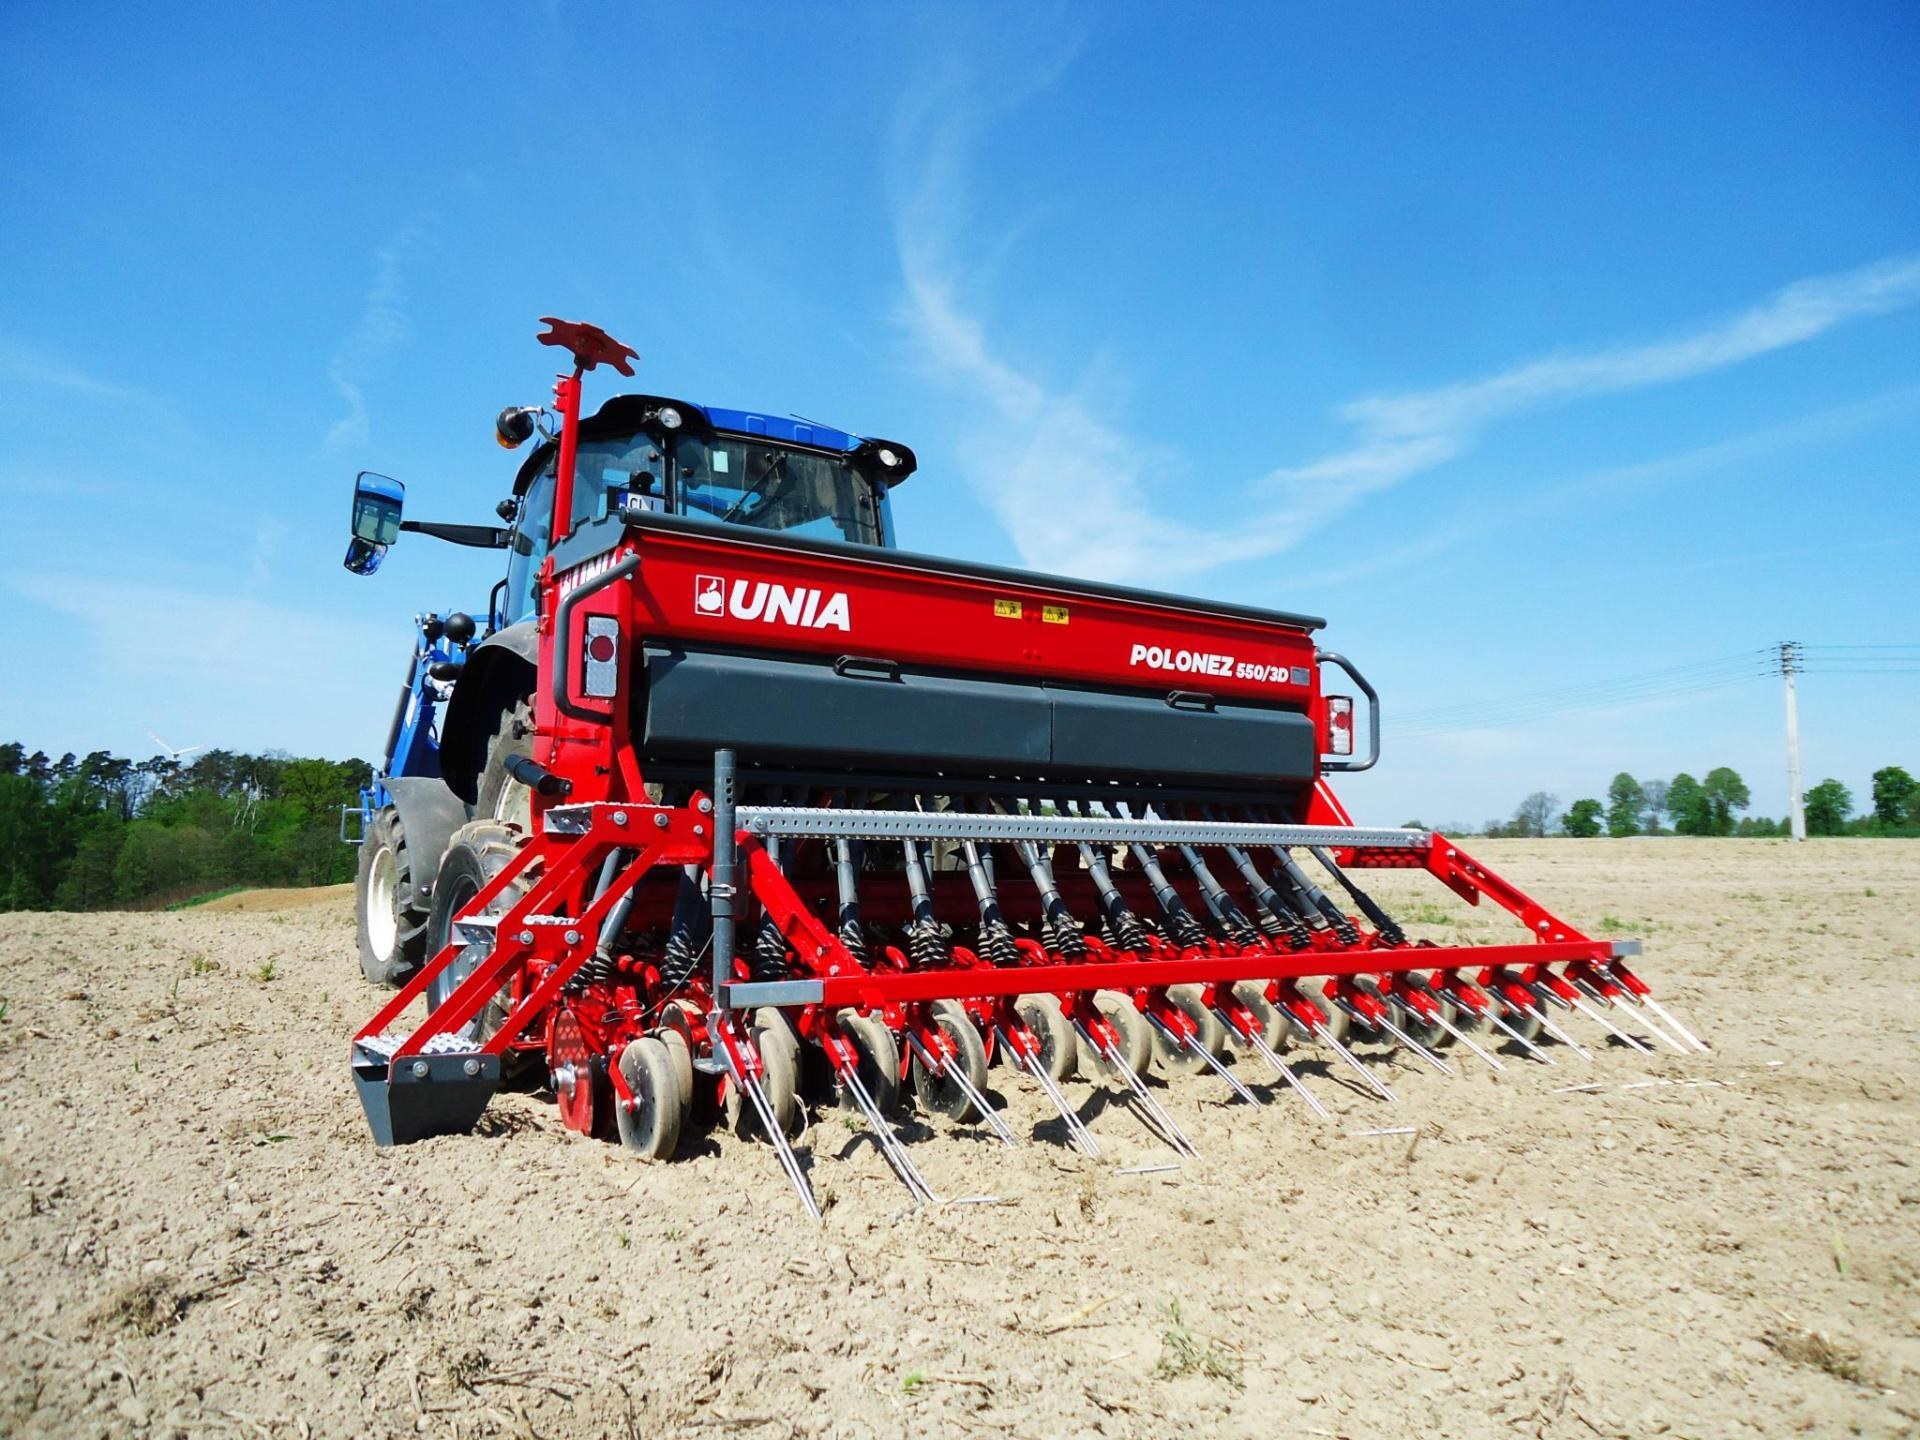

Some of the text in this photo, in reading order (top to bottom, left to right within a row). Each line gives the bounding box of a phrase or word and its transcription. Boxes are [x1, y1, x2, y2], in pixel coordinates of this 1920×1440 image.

[729, 579, 850, 632] UNIA
[1129, 644, 1289, 683] POLONEZ 550/3D
